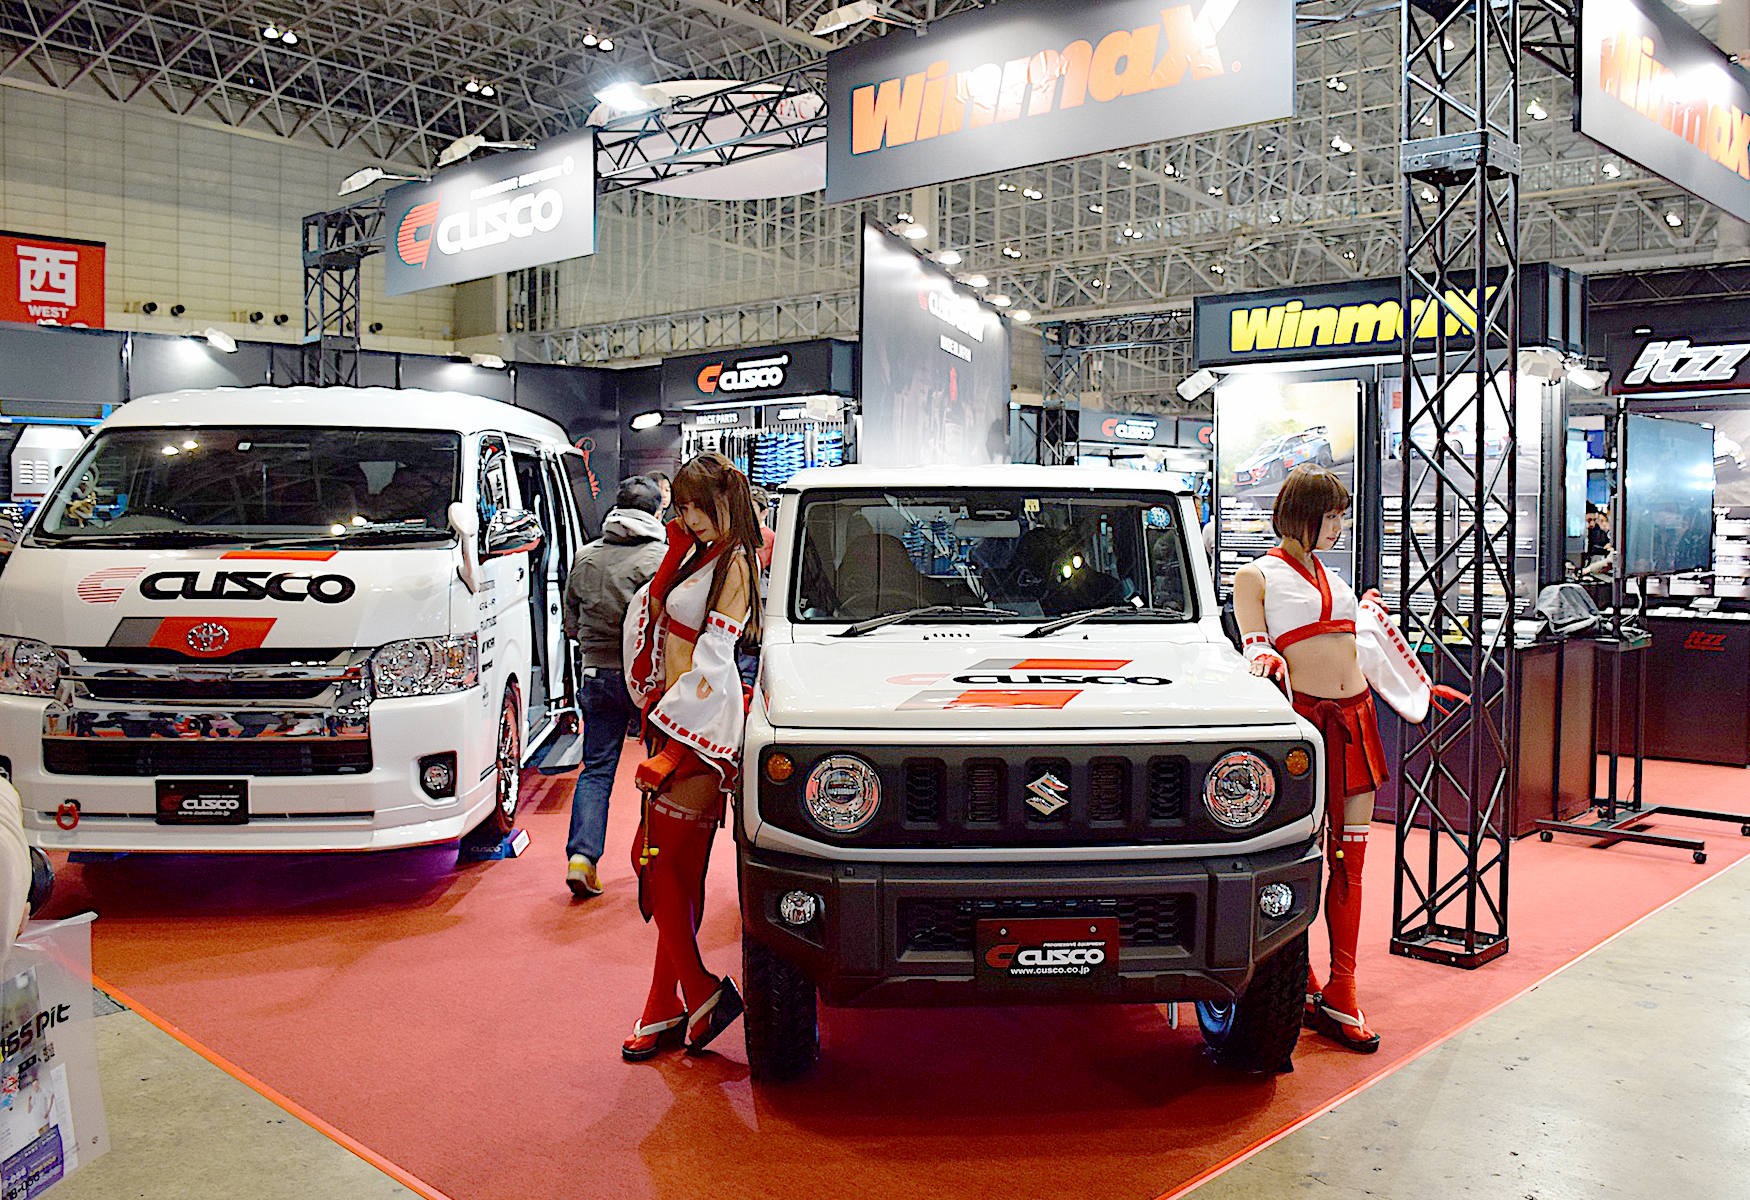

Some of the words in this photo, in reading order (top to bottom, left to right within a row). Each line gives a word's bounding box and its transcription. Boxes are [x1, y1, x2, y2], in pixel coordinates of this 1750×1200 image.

[16, 245, 79, 307] 西
[28, 304, 70, 319] WEST
[140, 571, 356, 604] CUSCO
[952, 675, 1173, 686] CUSCO
[182, 799, 240, 810] CUSCO
[1018, 949, 1105, 966] CUSCO
[1010, 966, 1091, 975] www.cusco.co.jp
